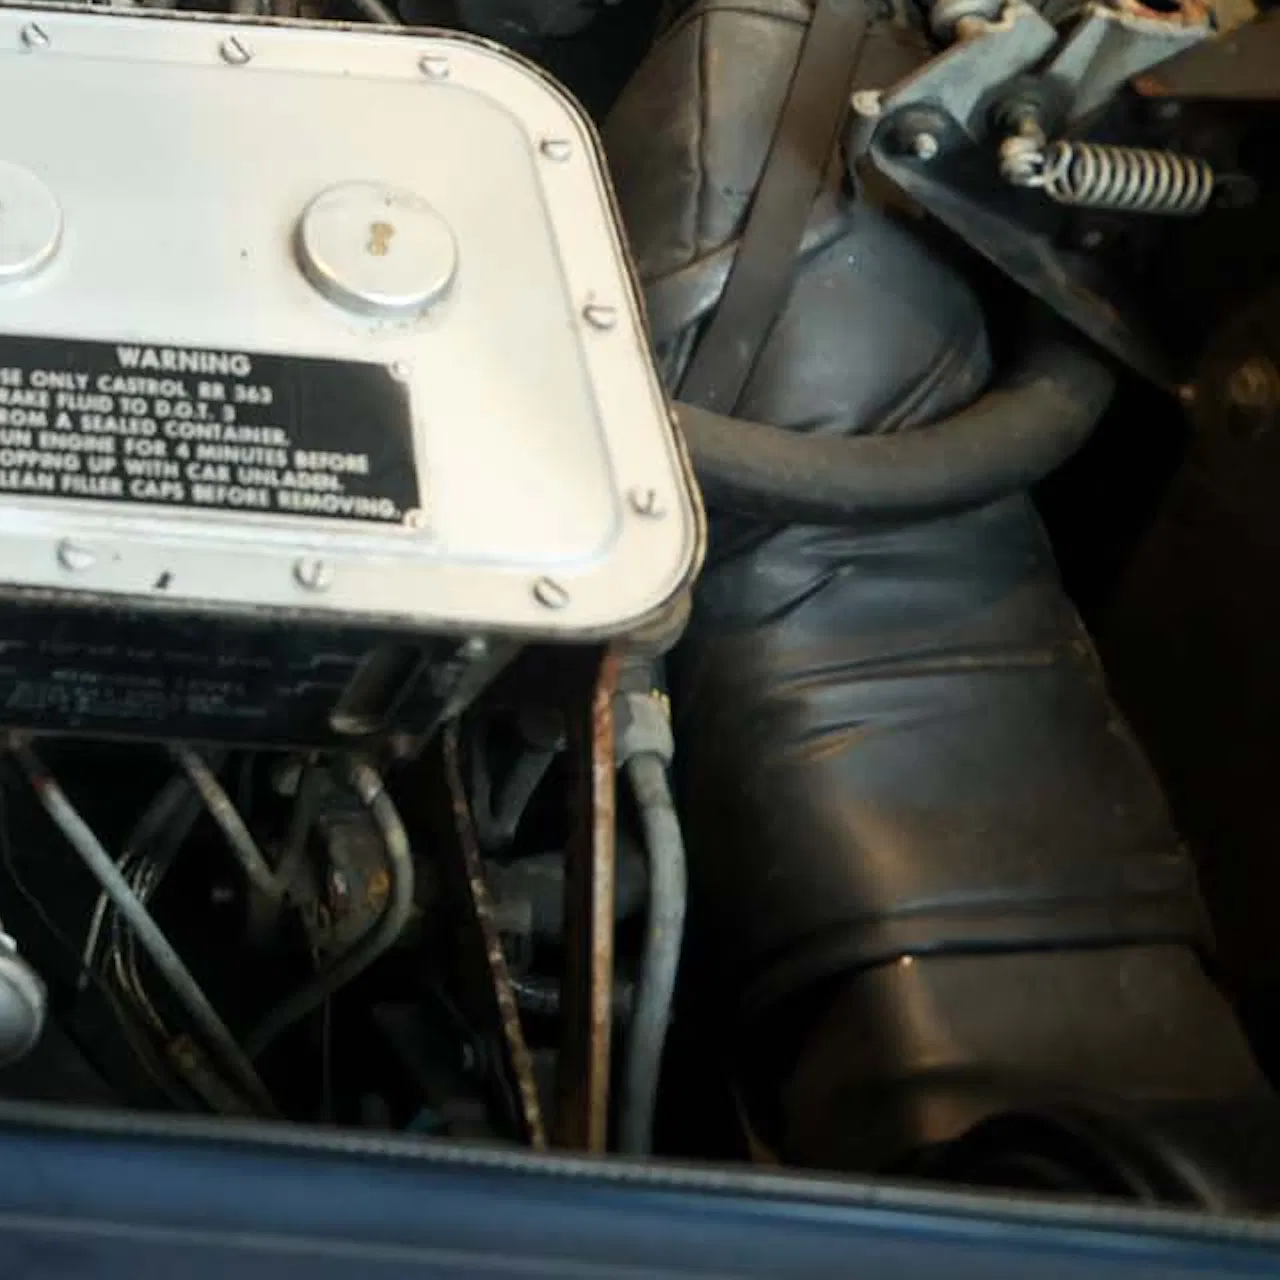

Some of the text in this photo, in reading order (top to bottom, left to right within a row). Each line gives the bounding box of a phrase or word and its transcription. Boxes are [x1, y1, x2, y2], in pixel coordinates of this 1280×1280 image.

[116, 345, 252, 378] WARNING
[29, 369, 89, 391] ONLY
[96, 373, 187, 398] CASTROL
[196, 380, 226, 402] RR
[233, 383, 274, 405] 363
[56, 391, 114, 413] FLUID
[118, 395, 149, 416] TO
[54, 411, 73, 431] A
[79, 414, 158, 437] SEALED
[163, 420, 291, 447] CONTAINER.
[37, 431, 116, 455] ENGINE
[123, 437, 168, 458] FOR
[195, 443, 288, 468] MINUTES
[294, 449, 369, 475] BEFORE
[87, 454, 117, 473] UP
[122, 457, 180, 479] WITH
[186, 462, 231, 484] CAR
[236, 467, 346, 493] UNLADEN.
[60, 473, 123, 496] FILLER
[130, 478, 185, 501] CAPS
[191, 483, 271, 507] BEFORE
[277, 489, 402, 519] REMOVING.
